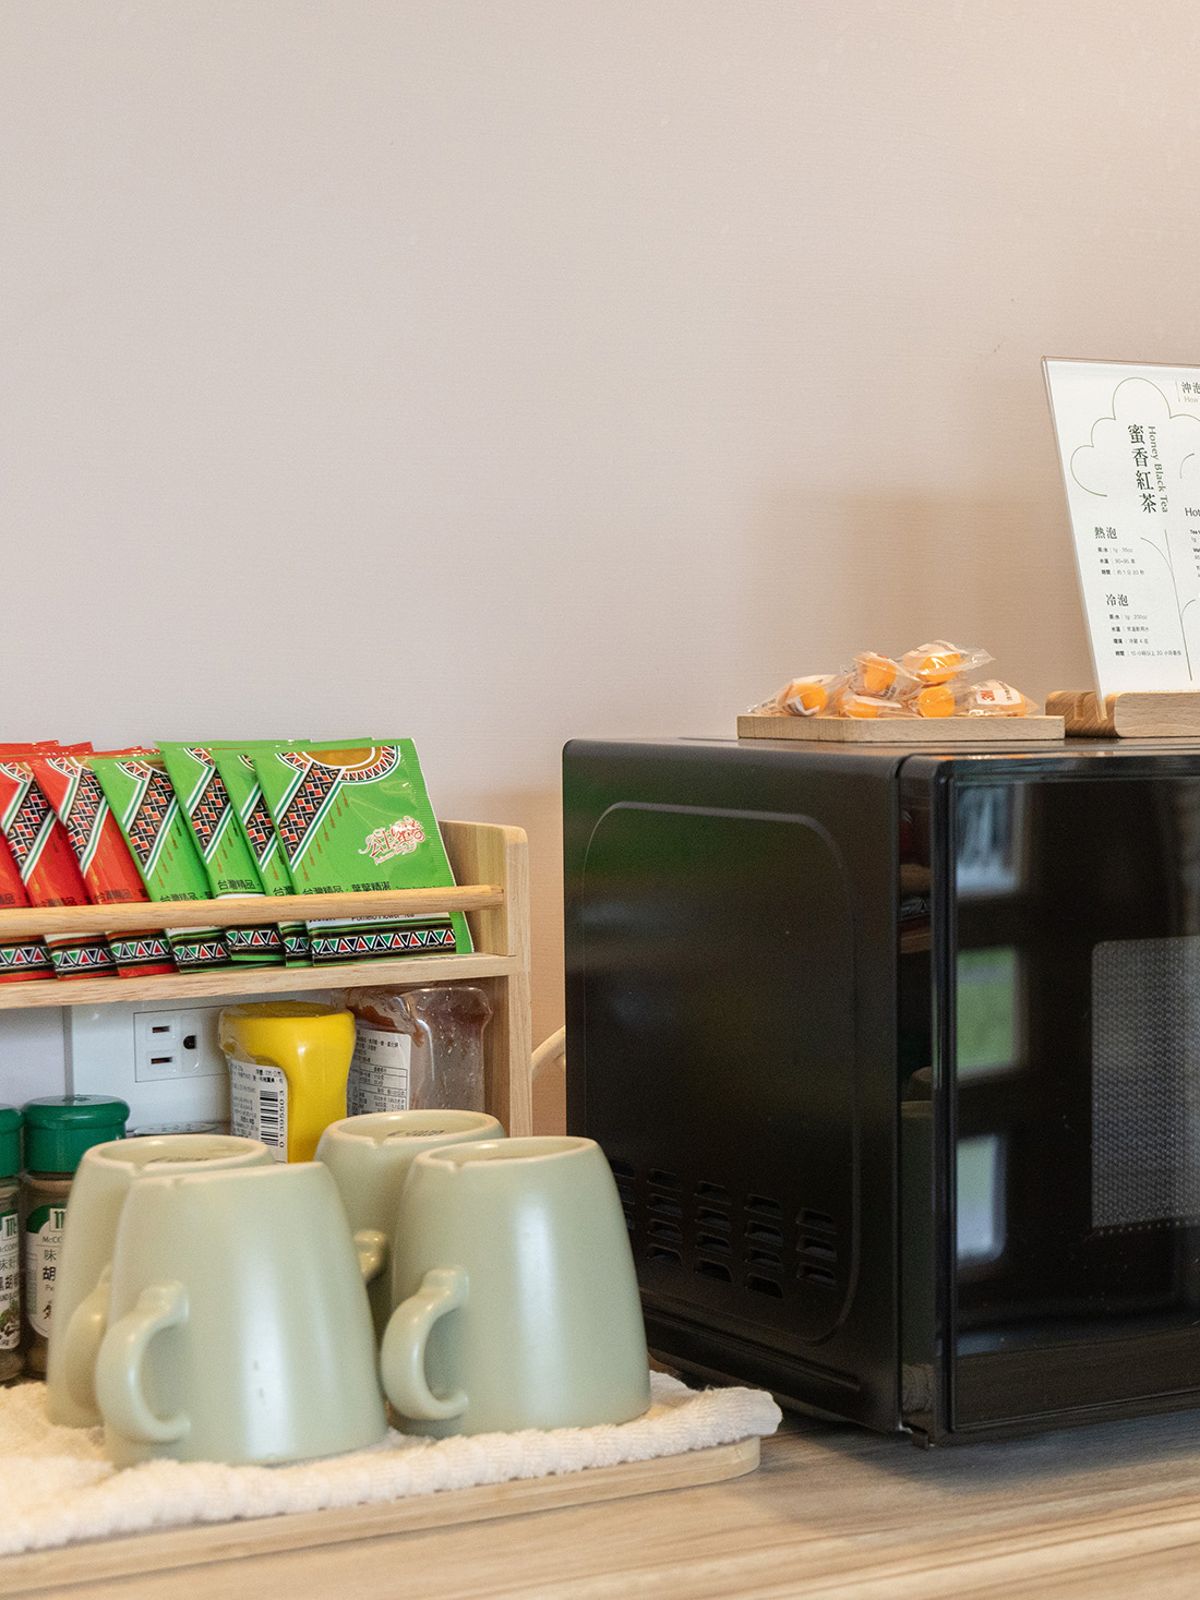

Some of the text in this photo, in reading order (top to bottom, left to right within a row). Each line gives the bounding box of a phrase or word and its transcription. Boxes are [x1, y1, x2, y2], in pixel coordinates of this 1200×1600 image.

[1128, 424, 1157, 513] 蜜香紅茶
[1148, 426, 1168, 513] Honey Black Tea
[1185, 507, 1200, 517] Hot
[1094, 527, 1118, 539] 熱泡
[1105, 594, 1129, 606] 冷泡
